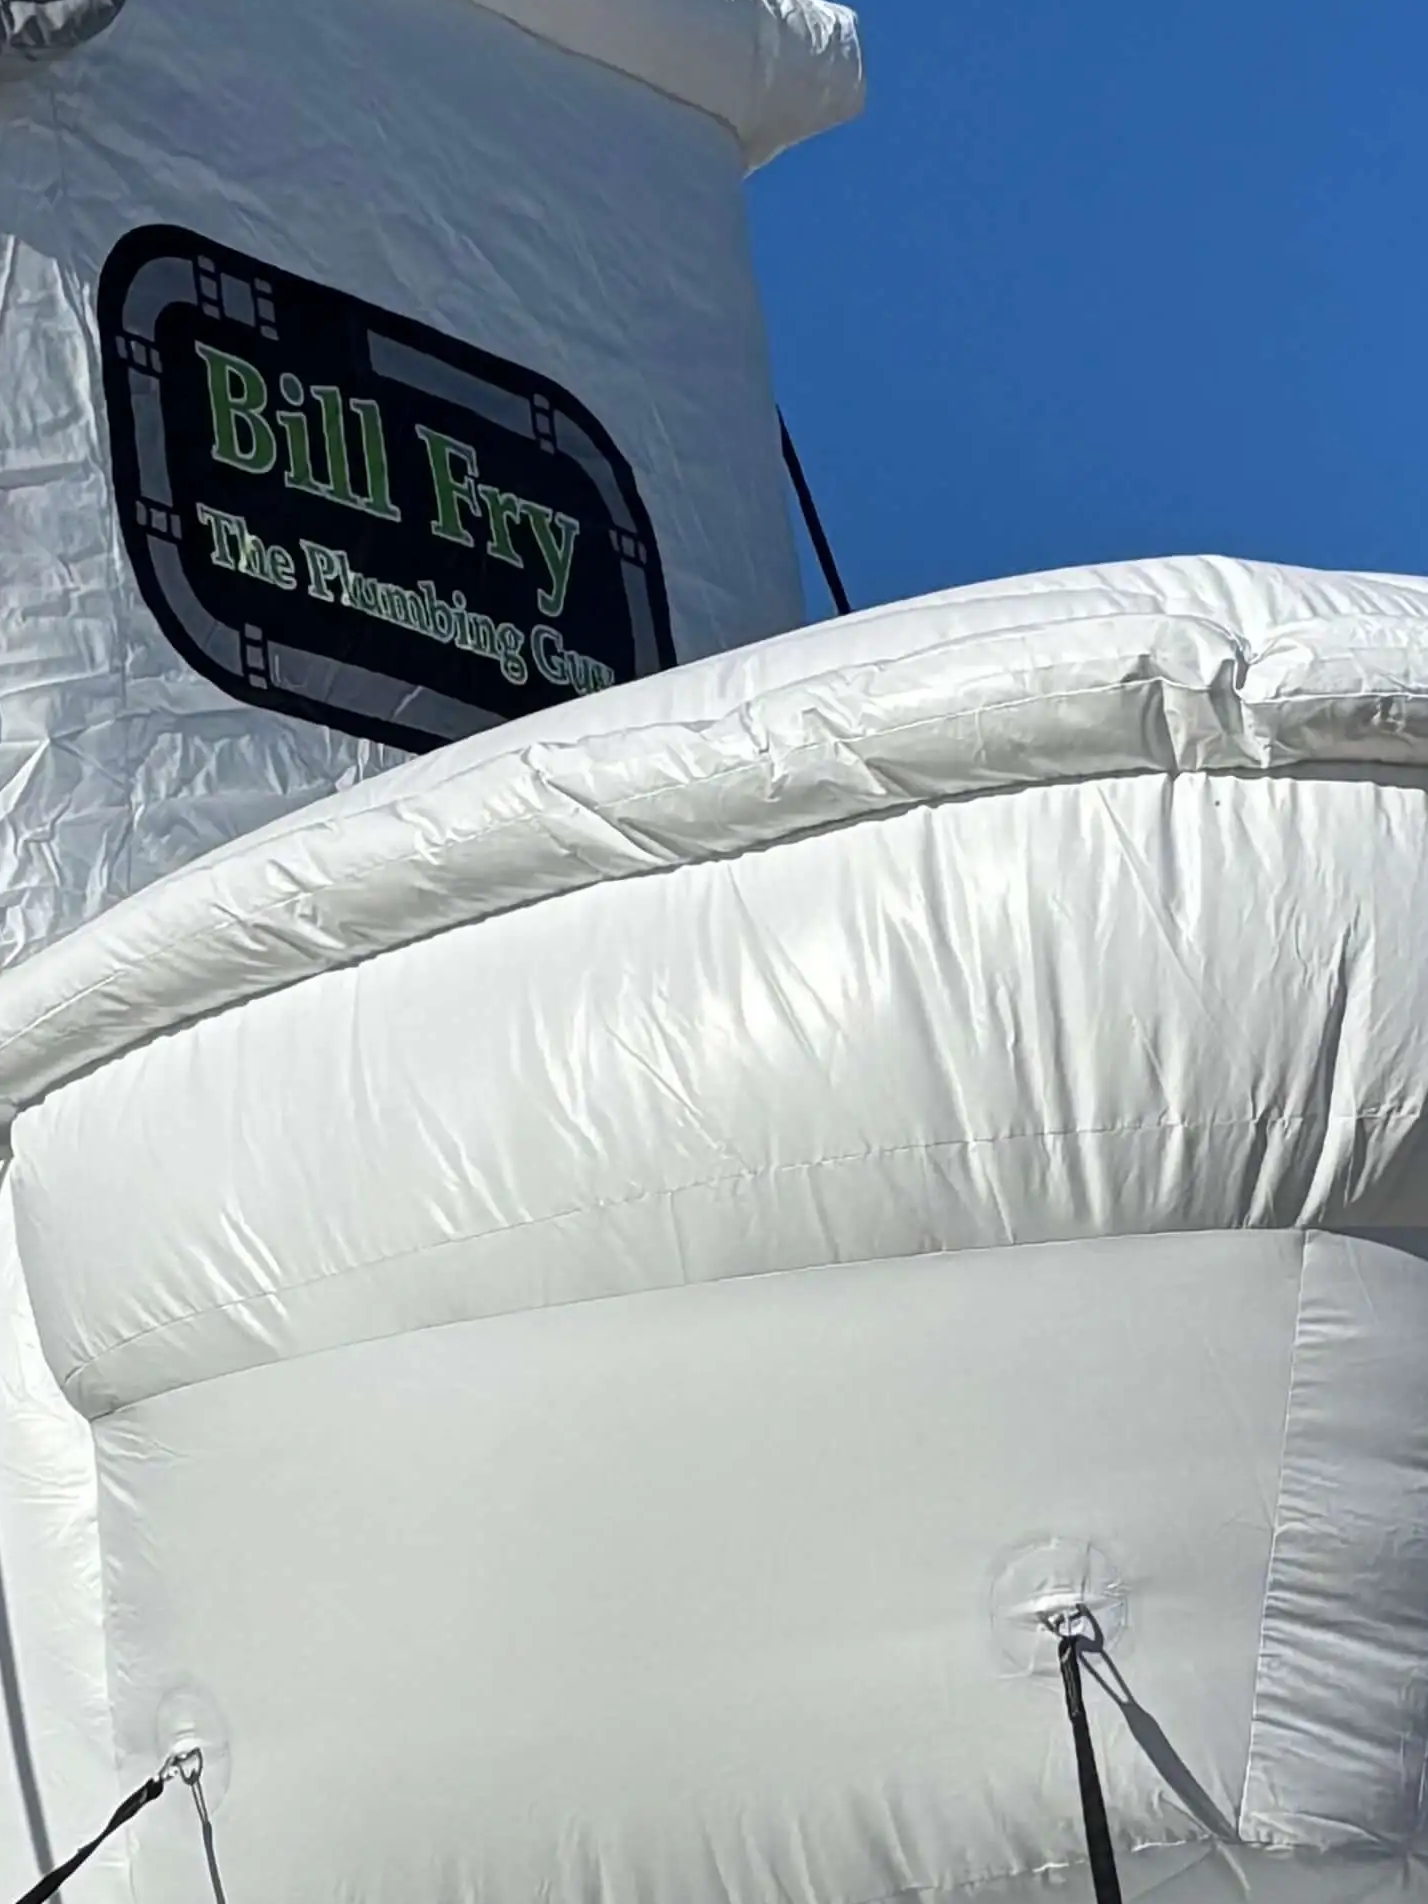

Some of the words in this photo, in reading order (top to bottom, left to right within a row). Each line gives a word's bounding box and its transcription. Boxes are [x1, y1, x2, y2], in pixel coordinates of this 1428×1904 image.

[195, 341, 400, 522] Bill
[416, 423, 579, 616] Fry
[196, 502, 297, 590] The
[299, 538, 528, 685] Plumbing
